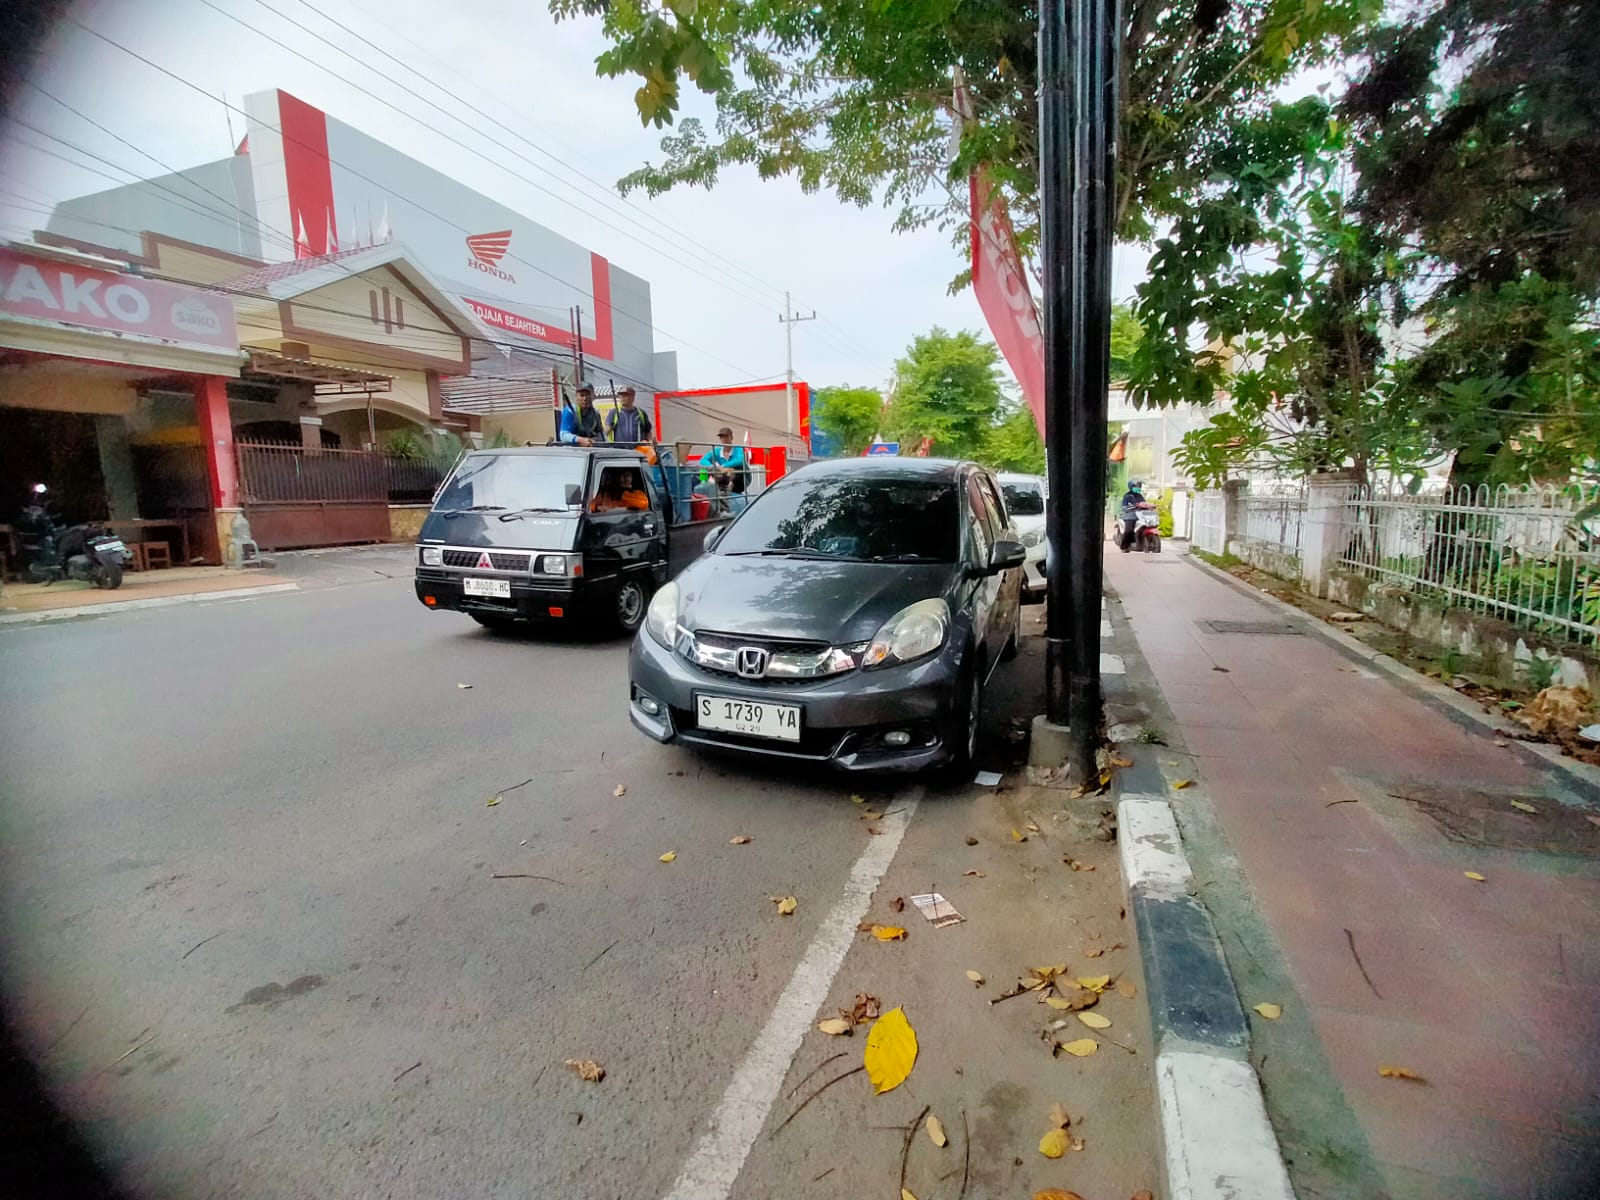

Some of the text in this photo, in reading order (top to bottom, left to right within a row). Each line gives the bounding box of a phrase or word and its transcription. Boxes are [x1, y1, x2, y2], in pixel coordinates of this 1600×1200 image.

[467, 258, 517, 284] HONDA
[0, 263, 150, 324] AKO
[477, 306, 503, 325] DJAJA
[504, 315, 547, 337] SEJAHTERA
[702, 699, 796, 728] S 1739 YA
